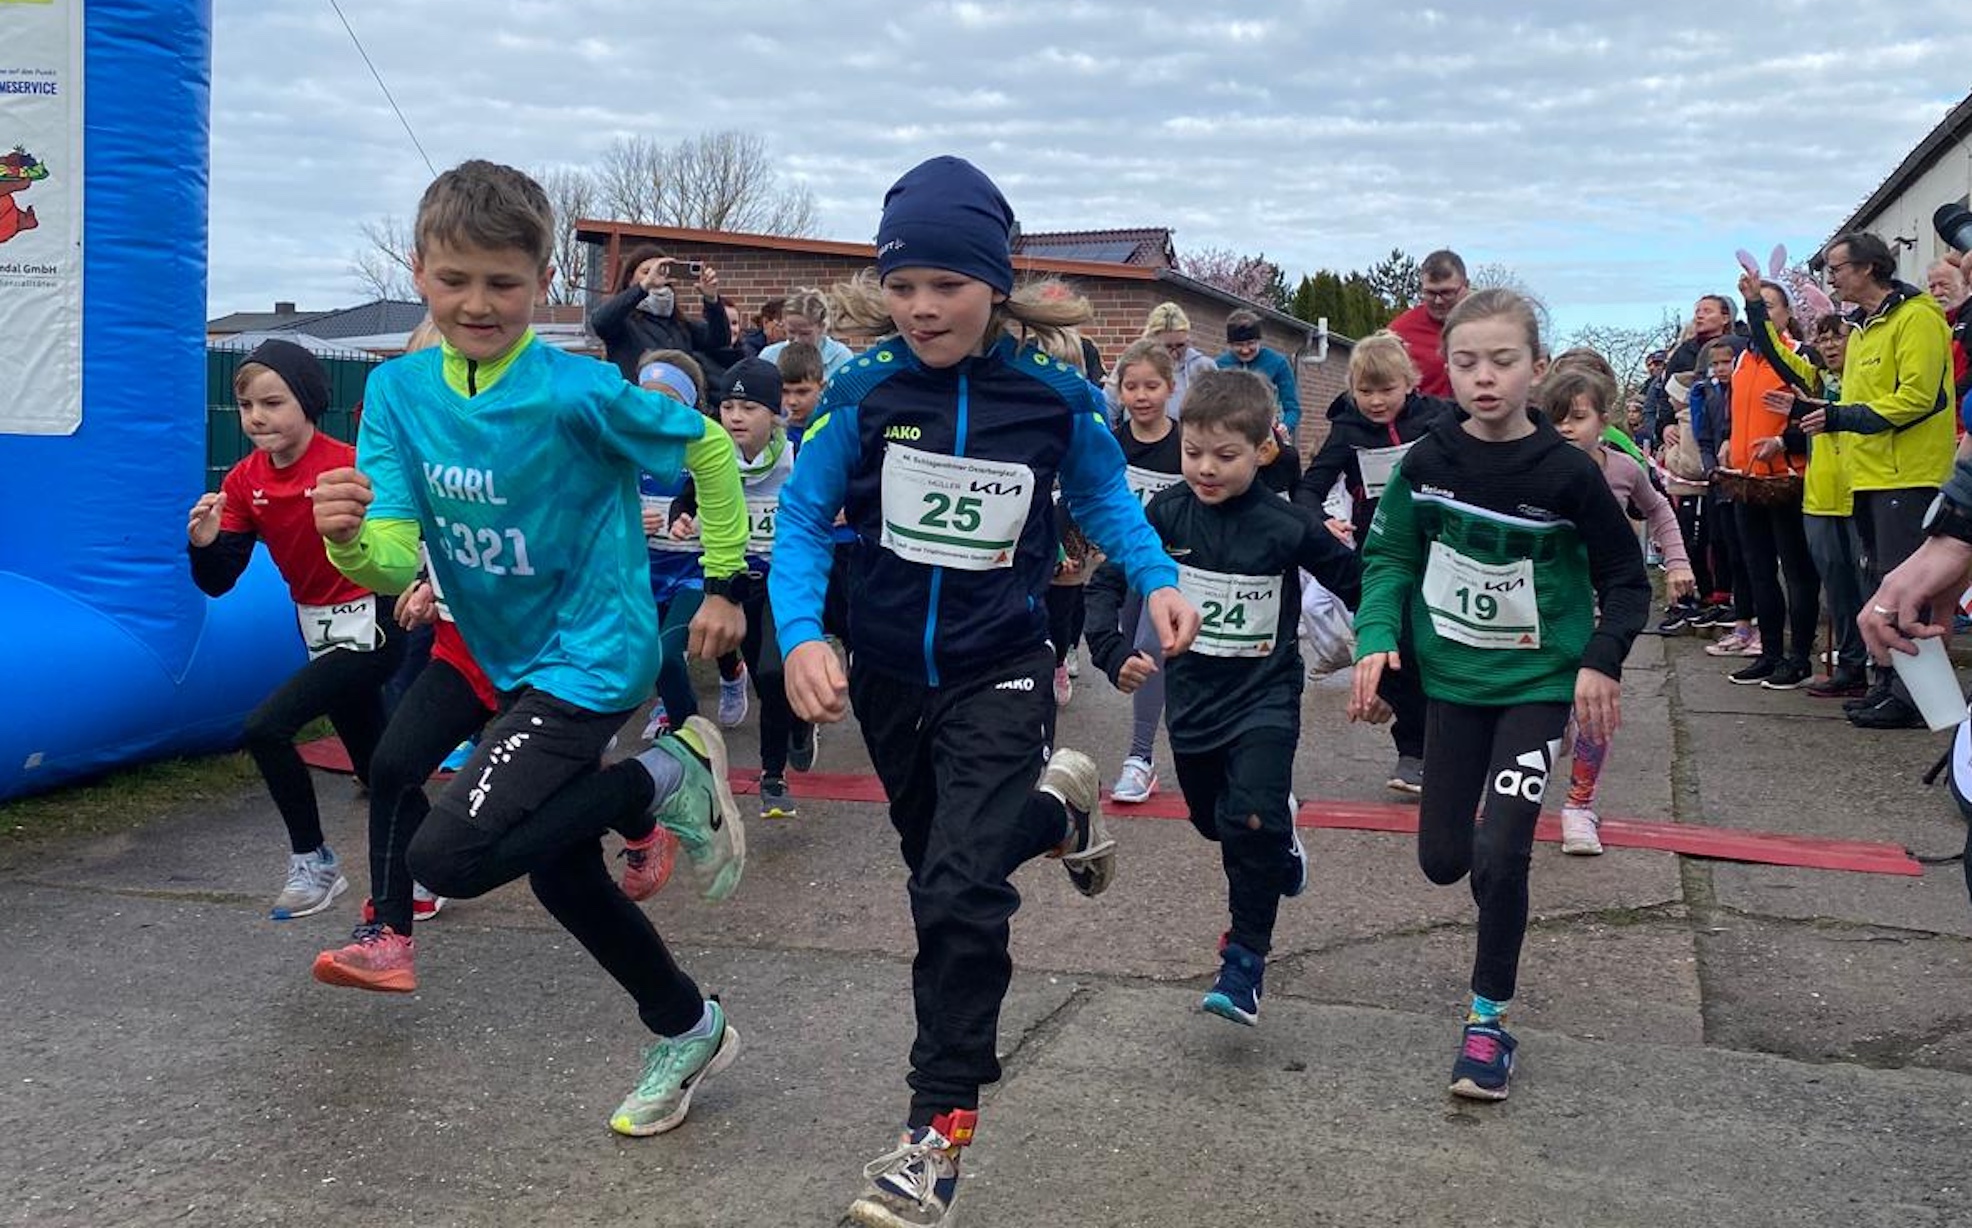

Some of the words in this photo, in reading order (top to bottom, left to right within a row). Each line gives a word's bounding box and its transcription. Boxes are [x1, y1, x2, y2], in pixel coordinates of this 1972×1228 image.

[23, 263, 57, 275] GmbH
[882, 425, 922, 441] JAKO
[422, 462, 507, 505] KARL
[970, 480, 1022, 497] KIA
[918, 491, 983, 533] 25
[1236, 590, 1273, 601] KIA
[1484, 578, 1525, 593] KIA
[1456, 586, 1499, 621] 19
[1201, 600, 1246, 630] 24
[317, 619, 332, 642] 7
